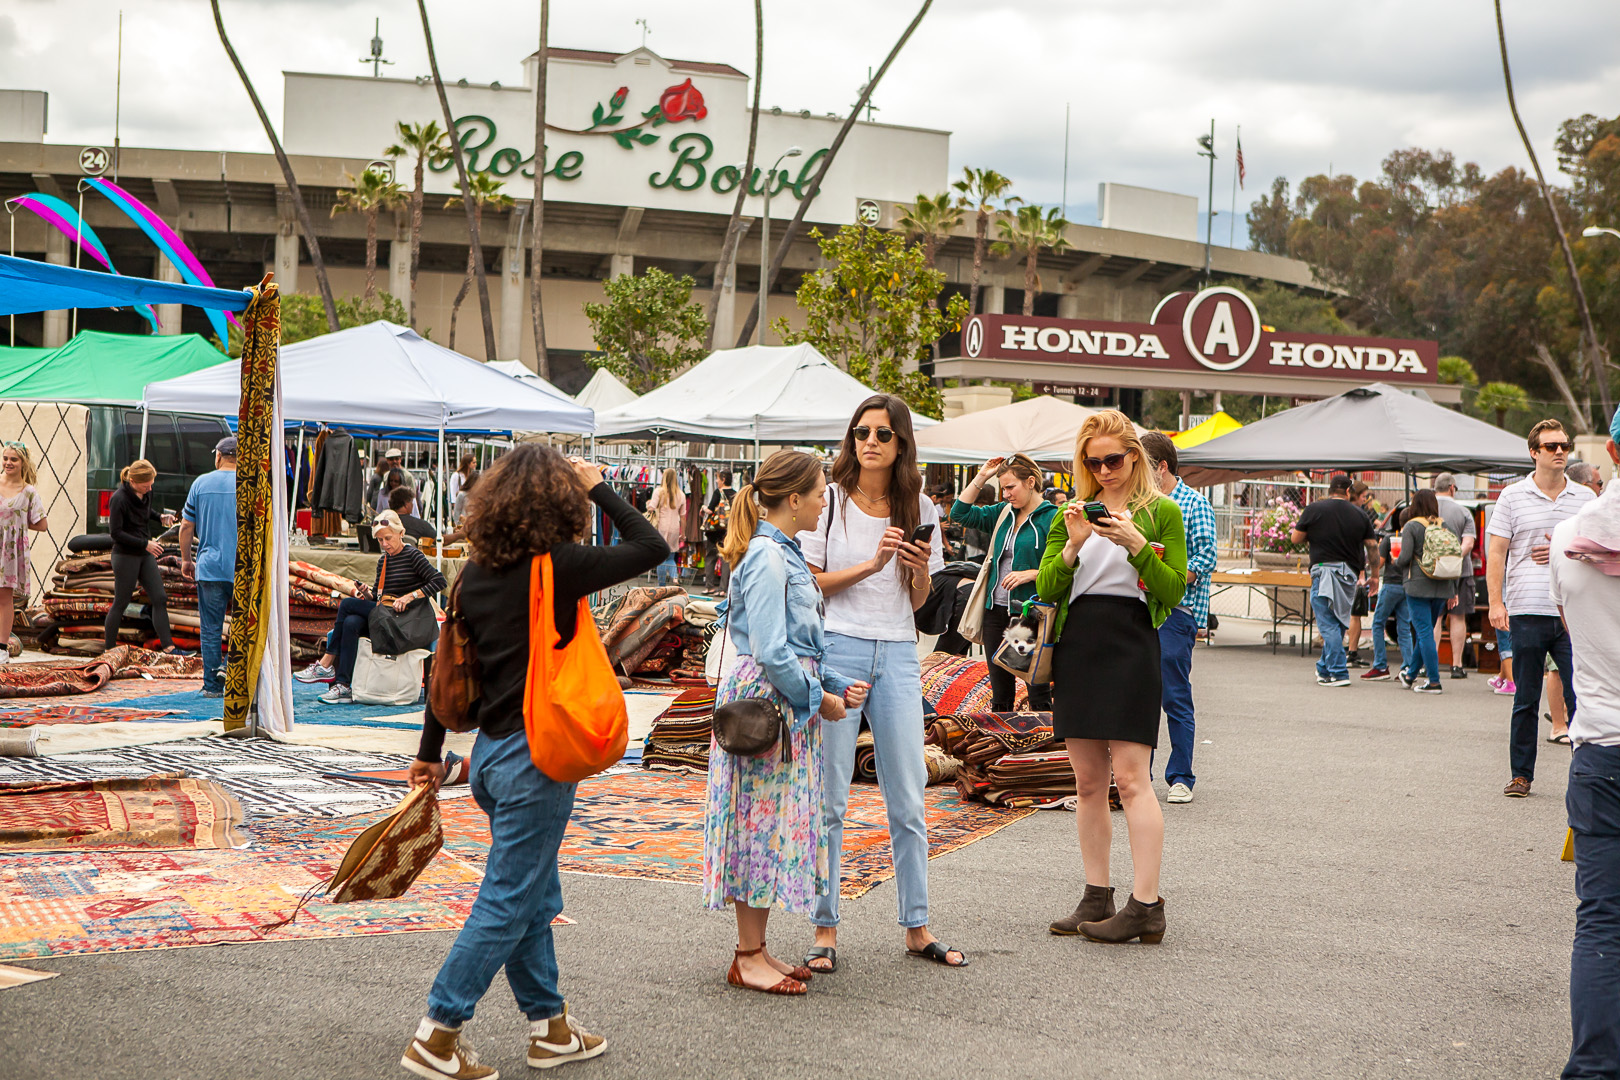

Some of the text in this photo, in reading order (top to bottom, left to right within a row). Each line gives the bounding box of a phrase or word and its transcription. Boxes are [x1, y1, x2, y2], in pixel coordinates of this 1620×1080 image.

[83, 151, 105, 169] 24
[428, 115, 830, 200] Rose Bowl
[860, 205, 878, 221] 26
[1001, 301, 1428, 374] HONDA A HONDA
[1053, 386, 1076, 395] Tunnels
[1078, 387, 1085, 396] 12
[1090, 388, 1099, 396] 24
